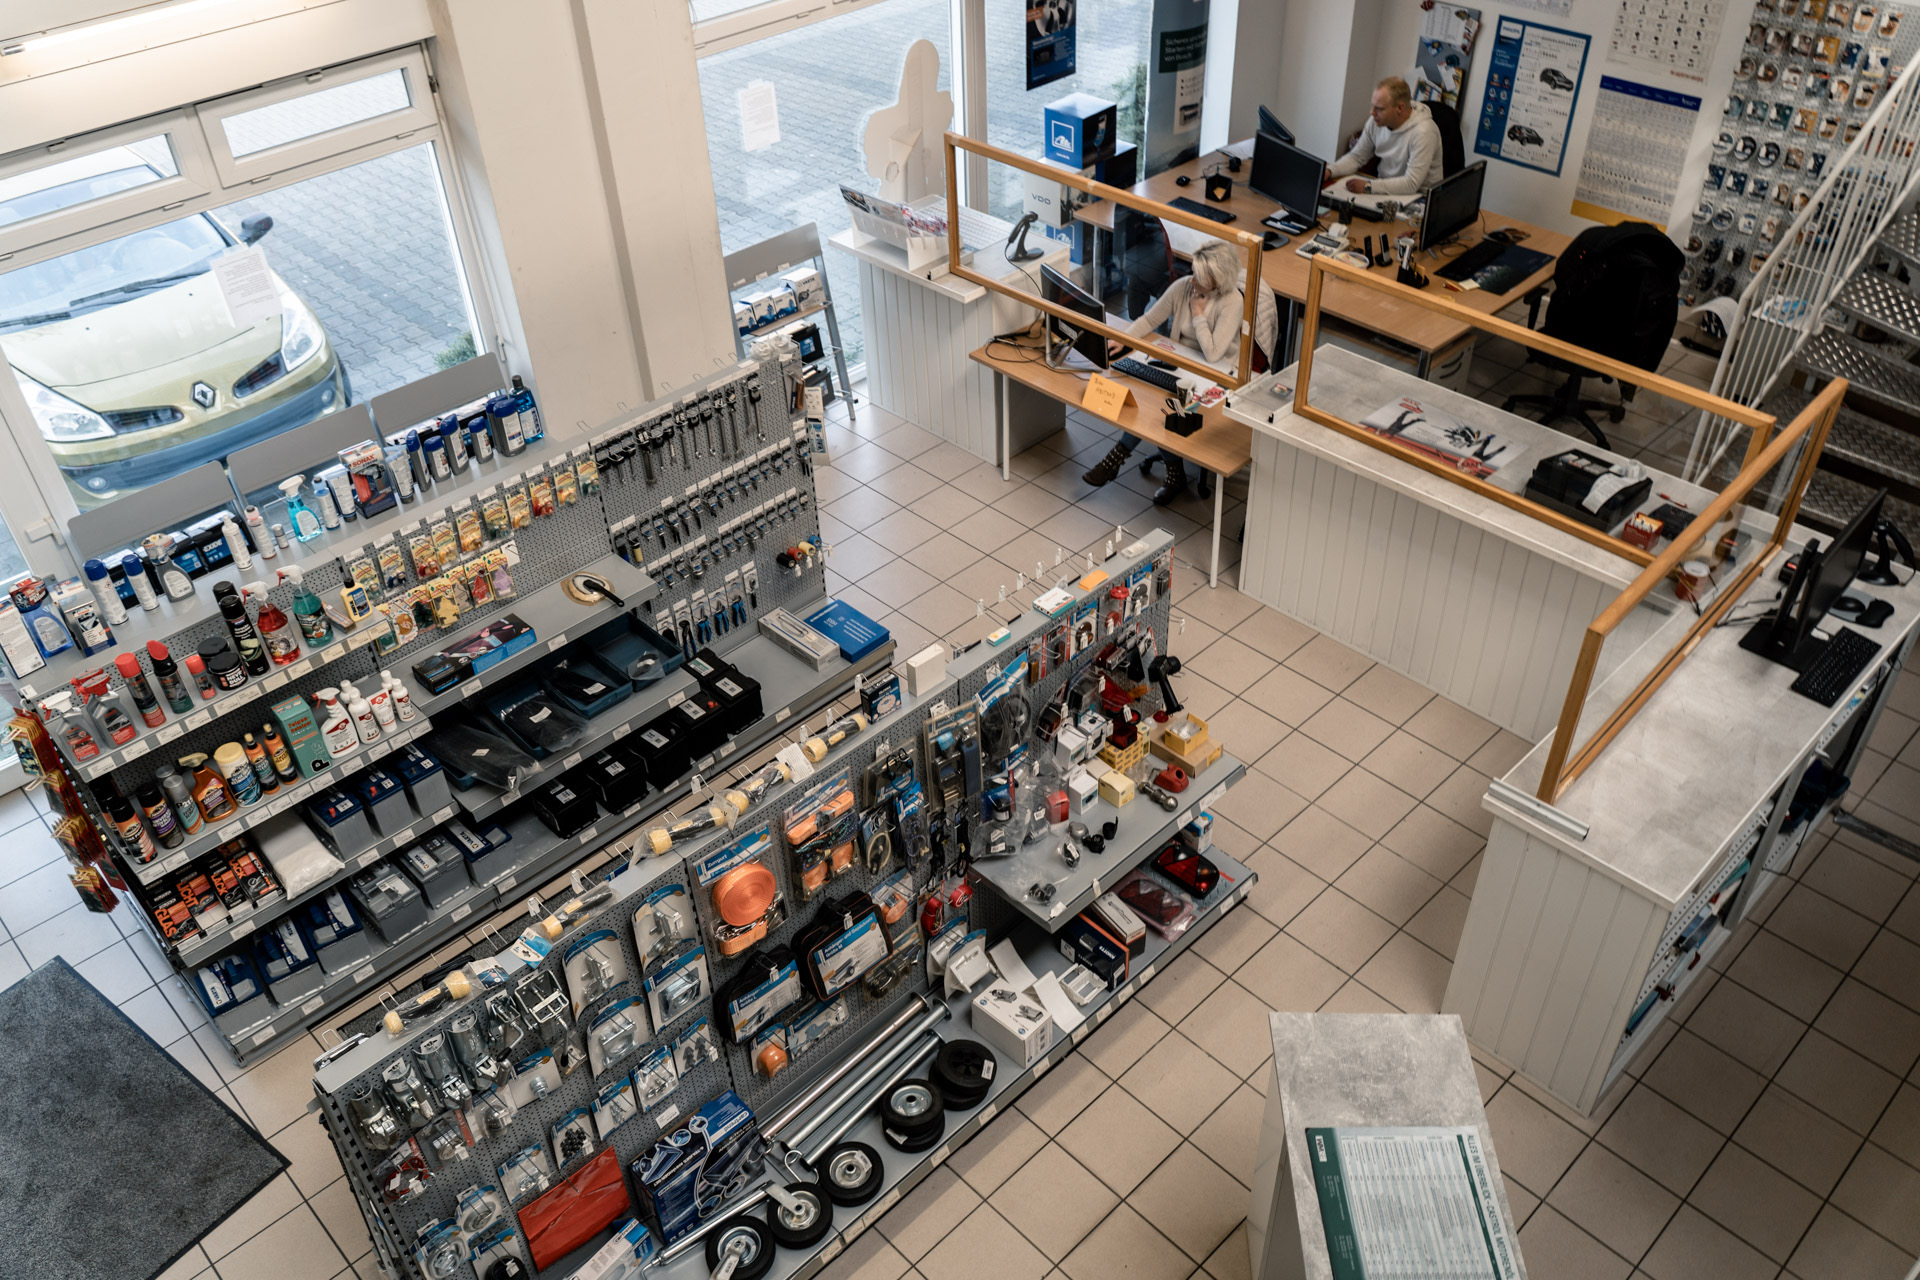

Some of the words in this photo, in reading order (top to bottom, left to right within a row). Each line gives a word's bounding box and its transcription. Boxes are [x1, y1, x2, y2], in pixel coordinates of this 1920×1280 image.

[1032, 193, 1051, 206] VDO
[352, 454, 375, 468] SONAX
[202, 538, 223, 552] EXIDE
[460, 831, 474, 846] VARTA
[414, 854, 426, 866] VARTA
[706, 853, 728, 868] Zurrgurt
[229, 858, 247, 880] LACK
[210, 874, 228, 896] LACK
[176, 882, 199, 907] LICHT
[154, 908, 178, 938] GLAS
[285, 922, 294, 937] VARTA
[824, 938, 844, 954] Anhänger-
[1099, 945, 1116, 960] KNOTT
[210, 986, 220, 1000] VARTA
[738, 990, 760, 1003] Anhänger-
[724, 1112, 748, 1132] cartrend
[1467, 1134, 1478, 1154] ALLES
[1472, 1155, 1481, 1164] IM
[1474, 1165, 1491, 1200] ÜBERBLICK
[1487, 1205, 1502, 1235] CASTROL
[613, 1223, 634, 1243] cartrend
